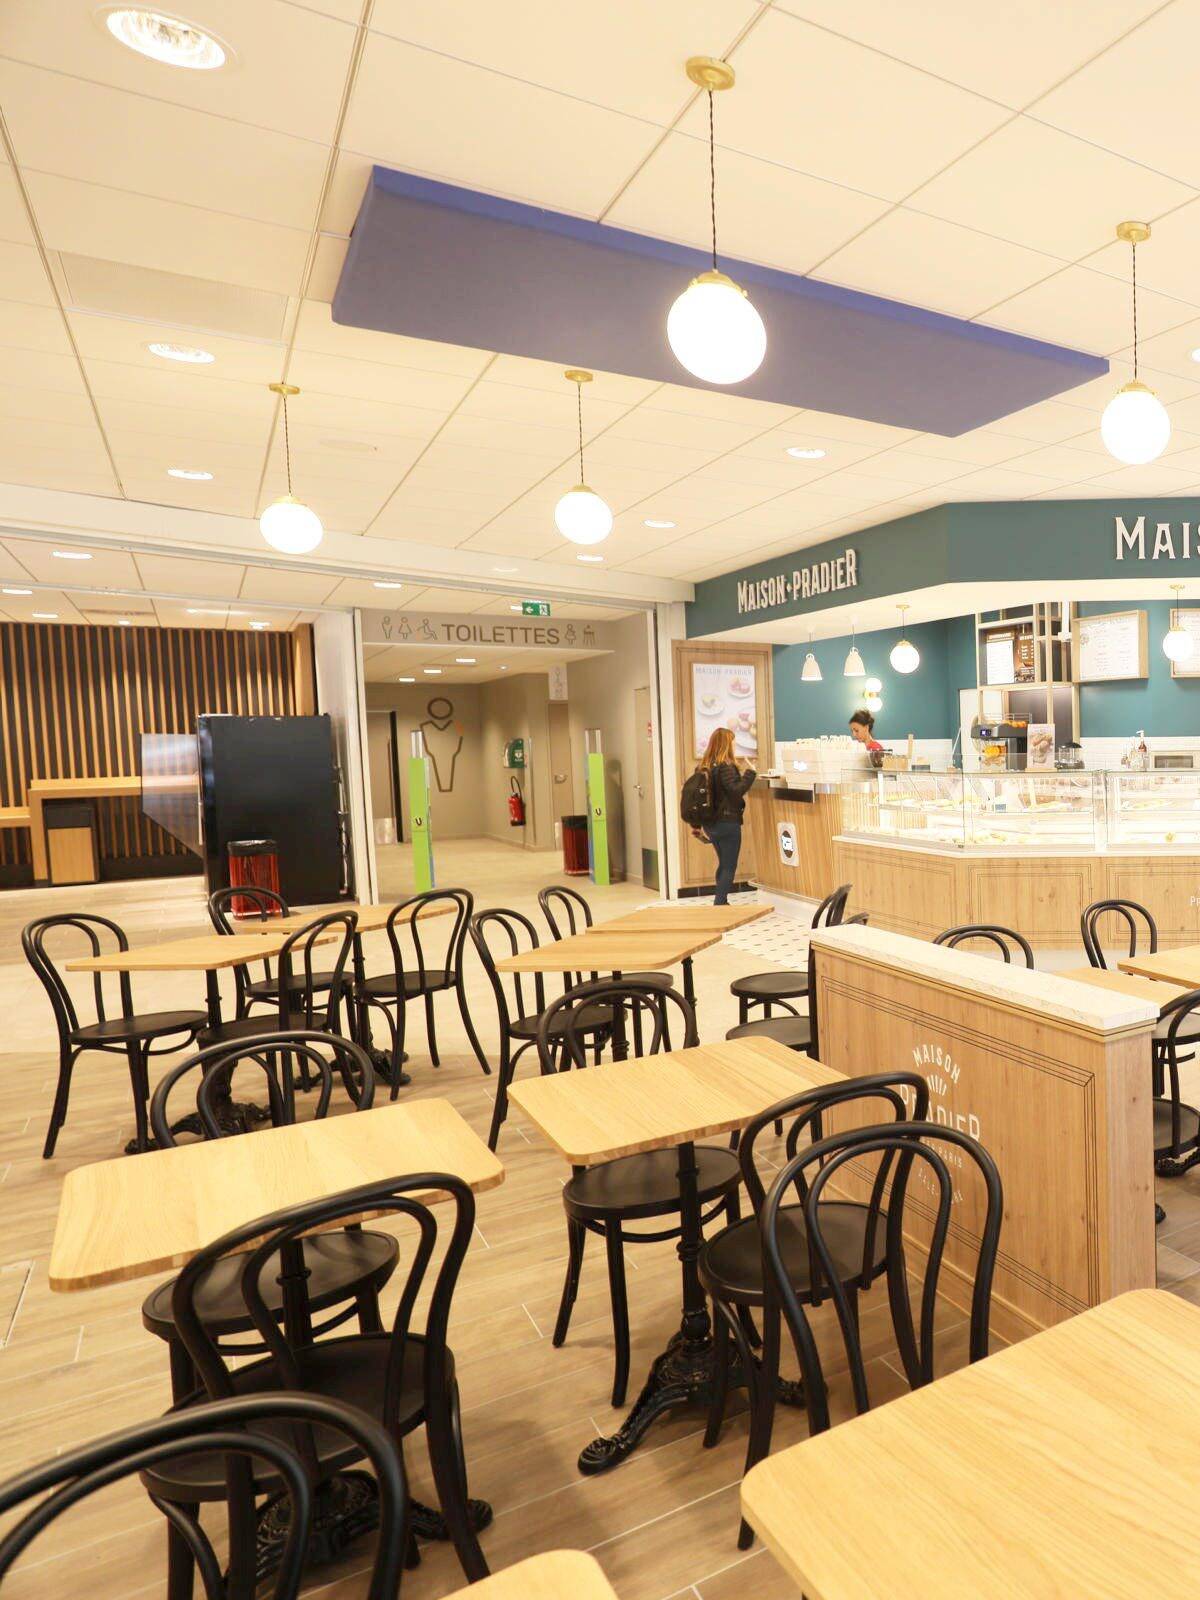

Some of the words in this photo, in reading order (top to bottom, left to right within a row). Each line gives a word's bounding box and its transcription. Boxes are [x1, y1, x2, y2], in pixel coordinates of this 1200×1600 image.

[737, 575, 787, 613] MAISON
[792, 548, 857, 600] PRADIER
[441, 623, 560, 645] TOILETTES
[912, 1044, 961, 1084] MAISON
